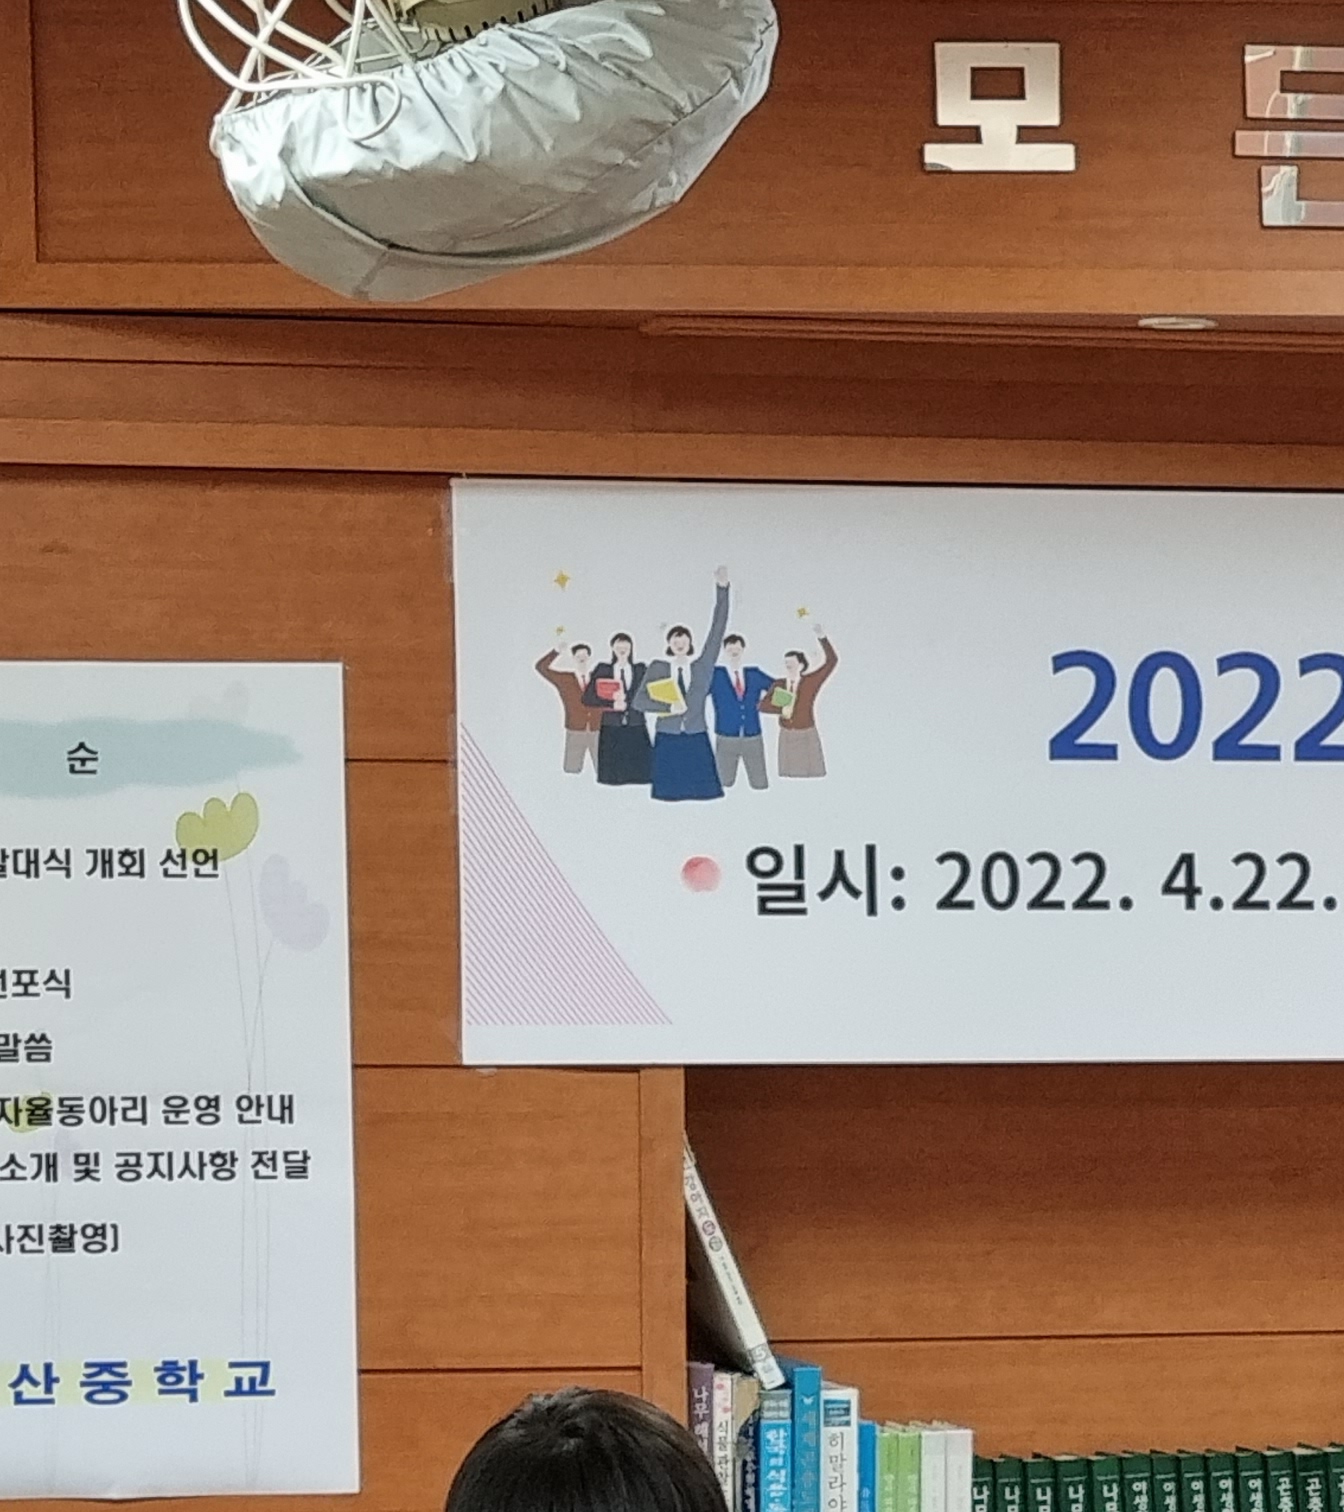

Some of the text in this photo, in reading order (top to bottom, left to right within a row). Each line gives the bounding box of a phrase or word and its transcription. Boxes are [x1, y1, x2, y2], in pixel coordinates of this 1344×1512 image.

[66, 741, 100, 775] 순
[85, 847, 149, 880] 개회
[159, 846, 221, 880] 선언
[744, 843, 907, 917] 일시:
[934, 850, 1135, 912] 2022.
[0, 1094, 297, 1128] 자율동아리 운영 안내
[0, 1147, 312, 1183] 소개 및 공지사항 전달
